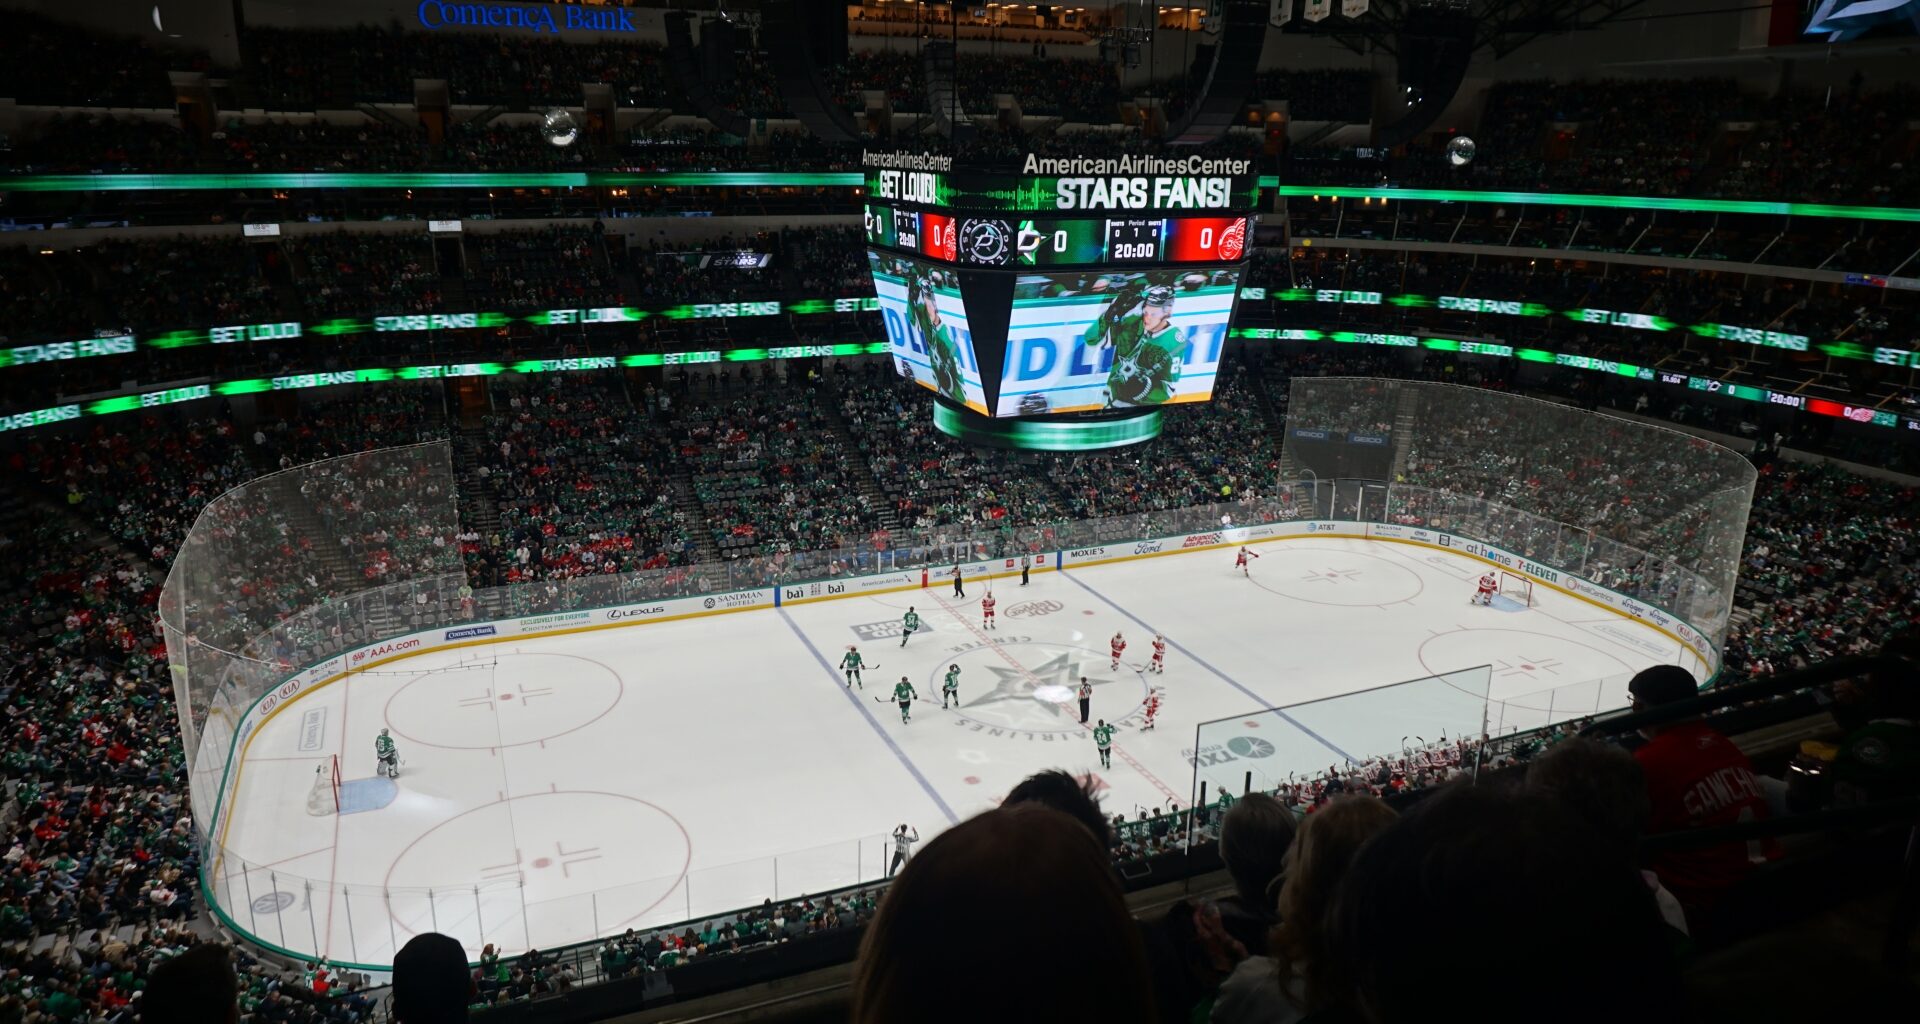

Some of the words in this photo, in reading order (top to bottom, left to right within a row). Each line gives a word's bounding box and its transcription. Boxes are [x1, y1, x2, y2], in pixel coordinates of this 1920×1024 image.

[565, 5, 636, 31] Bank
[862, 148, 953, 171] AmericanAirlinesCenter
[1023, 153, 1250, 175] AmericanAirlinesCenter
[880, 170, 900, 199] GET
[902, 171, 936, 204] LOUD!
[1056, 177, 1148, 209] STARS
[1154, 177, 1231, 209] FANS!
[876, 215, 882, 234] 0
[899, 231, 916, 248] 20:00
[933, 225, 940, 246] 0
[1054, 230, 1067, 252] 0
[1134, 228, 1139, 238] 1
[1200, 228, 1213, 249] 0
[1115, 243, 1154, 258] 20:00
[713, 257, 757, 266] STARS
[1316, 290, 1342, 302] GET
[1439, 296, 1480, 312] STARS
[693, 304, 739, 318] STARS
[834, 299, 861, 312] GET
[374, 315, 428, 331] STARS
[549, 309, 578, 325] GET
[1583, 308, 1611, 323] GET
[209, 326, 245, 343] GET
[1256, 329, 1276, 339] GET
[1354, 333, 1385, 345] STARS
[1717, 324, 1763, 344] STARS
[12, 343, 76, 365] STARS
[768, 346, 799, 359] STARS
[1459, 341, 1480, 352] GET
[541, 358, 581, 371] STARS
[664, 353, 684, 365] GET
[1556, 353, 1590, 369] STARS
[1873, 347, 1910, 366] GET
[417, 365, 442, 379] GET
[272, 373, 315, 389] STARS
[140, 393, 166, 407] GET
[1728, 385, 1735, 395] 0
[1770, 393, 1799, 407] 20:00
[1843, 407, 1851, 417] 0
[1296, 430, 1324, 439] GEICO
[1354, 436, 1382, 444] GEICO
[1071, 547, 1105, 558] MOXIE'S
[1134, 541, 1162, 555] Ford
[1466, 542, 1479, 555] at
[718, 591, 763, 603] SANDMAN
[727, 599, 756, 608] HOTELS
[622, 606, 664, 617] LEXUS
[1622, 599, 1644, 615] Kroger
[1650, 609, 1670, 626] Kroger
[477, 626, 493, 635] Bank
[370, 638, 420, 658] AAA.com
[280, 681, 299, 698] KIA
[261, 694, 276, 714] KIA
[955, 719, 1087, 741] AIRLINES
[1187, 750, 1238, 768] TXU
